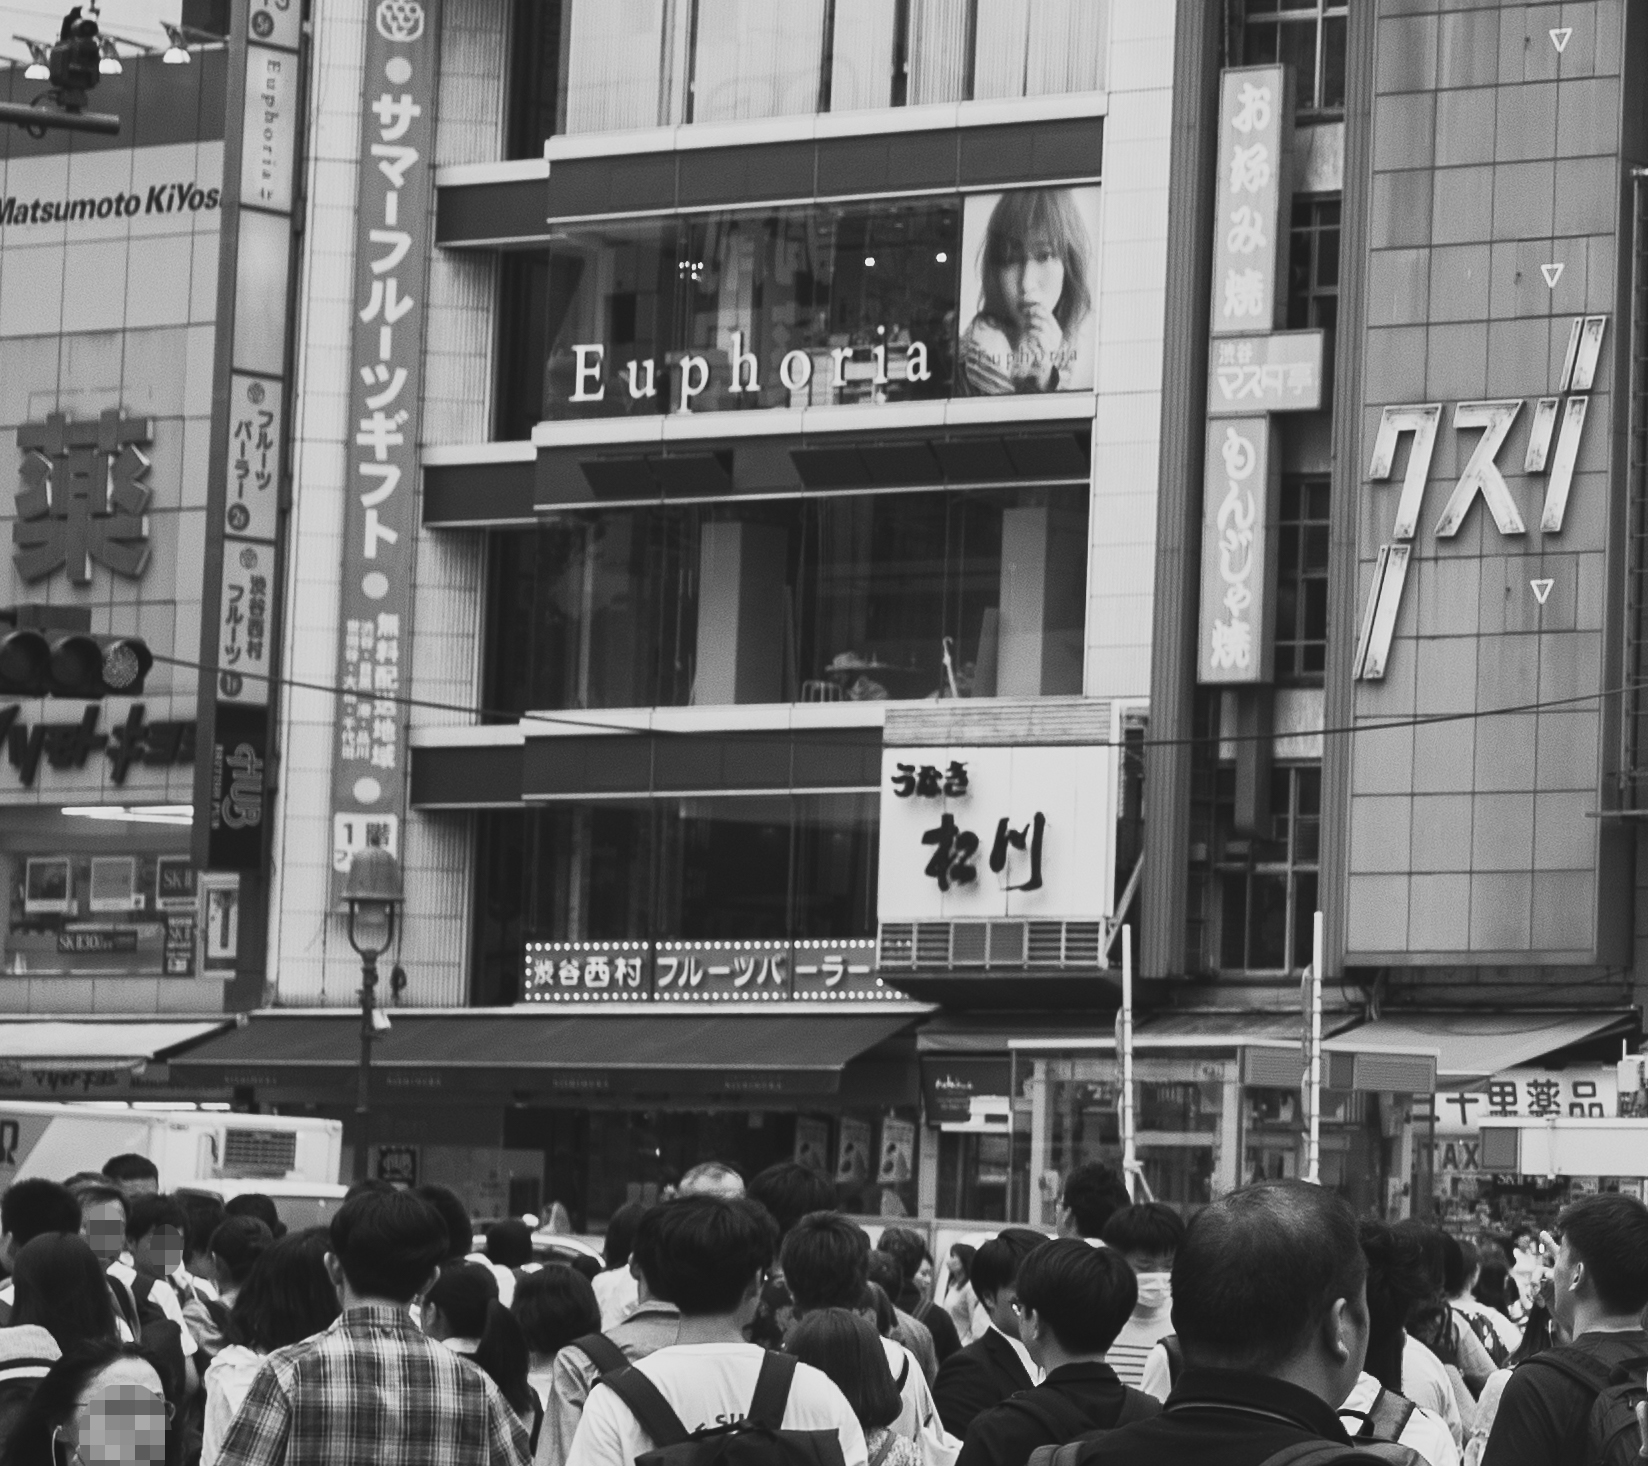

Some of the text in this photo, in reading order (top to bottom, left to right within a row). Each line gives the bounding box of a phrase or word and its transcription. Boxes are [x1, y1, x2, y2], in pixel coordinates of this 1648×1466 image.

[145, 183, 225, 215] KiYos
[1222, 81, 1275, 322] お好み焼
[356, 90, 422, 559] サマーフルーツギフト
[569, 331, 932, 415] Euphoria
